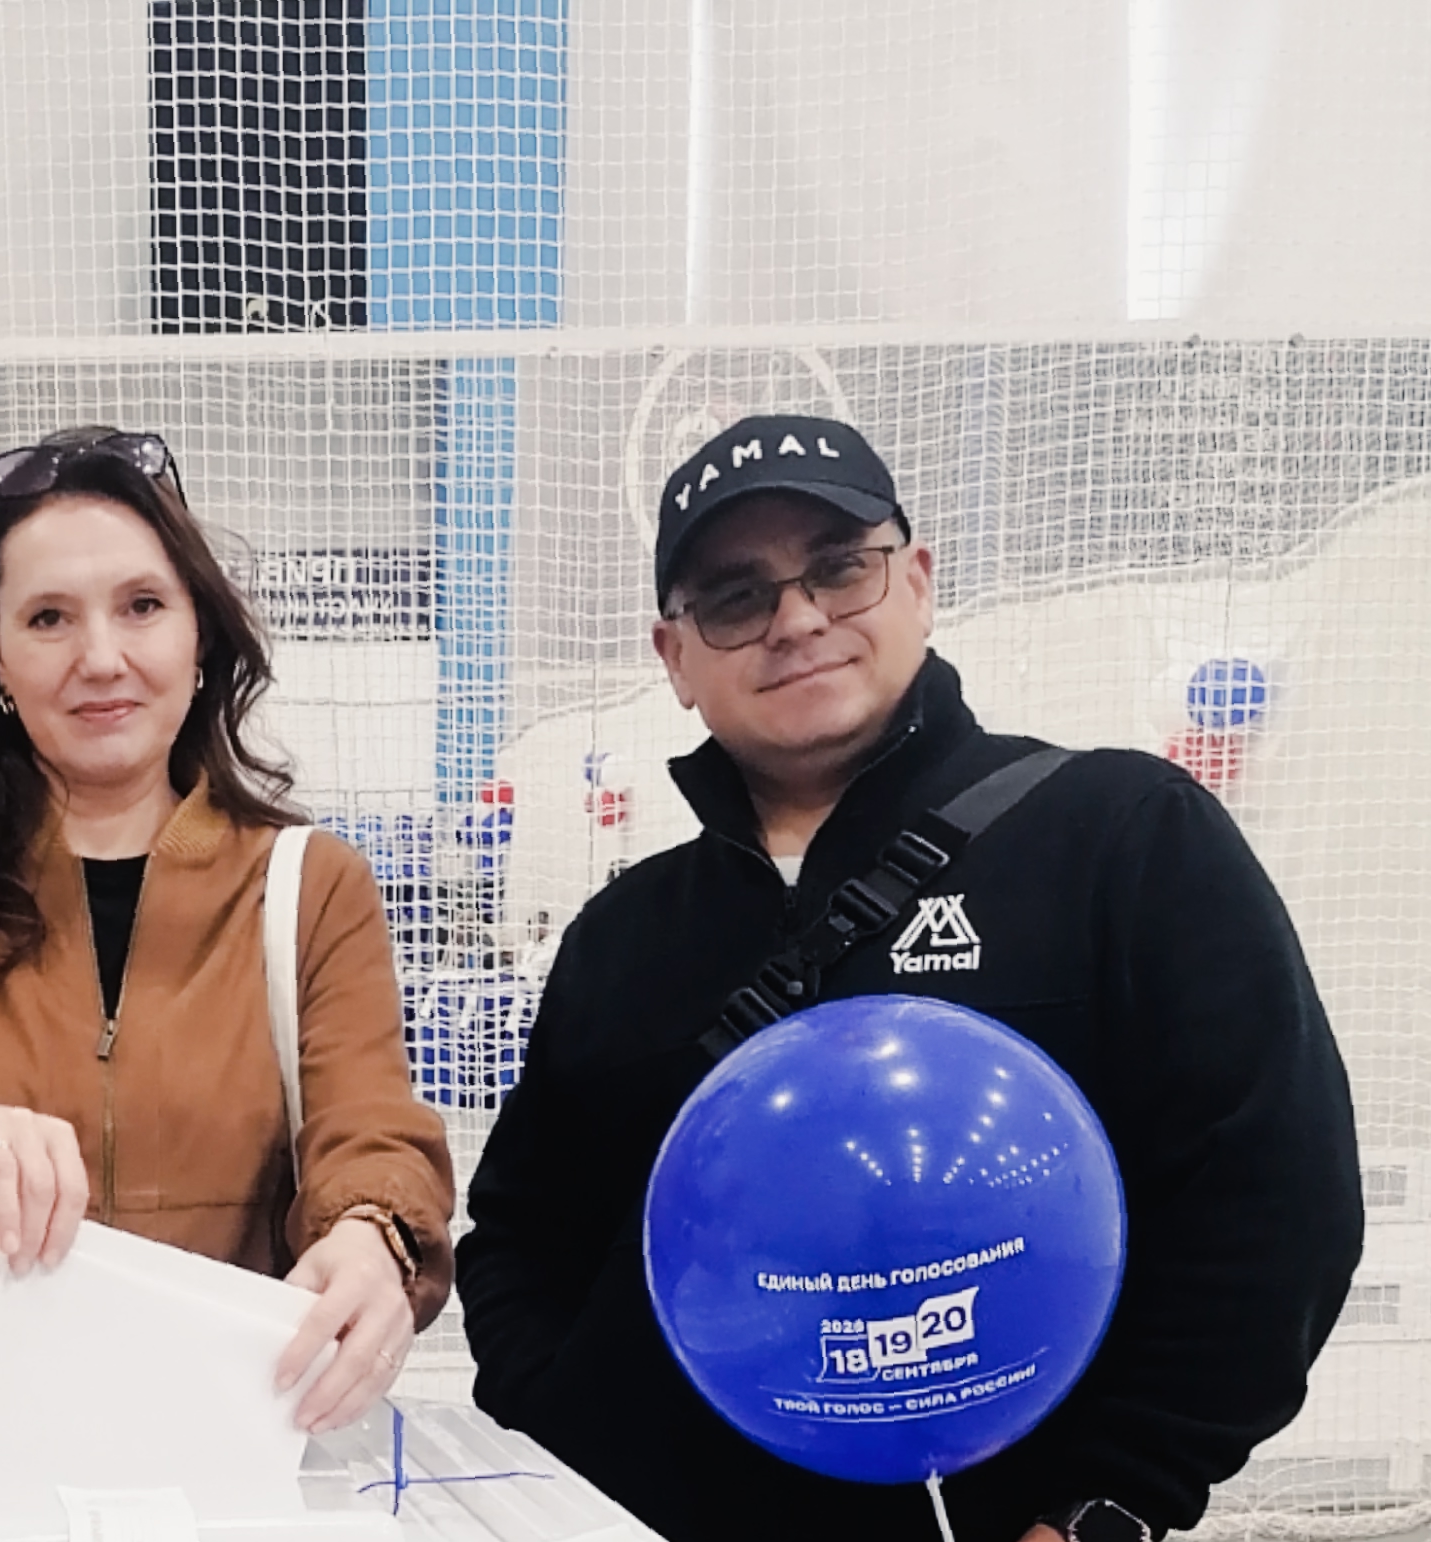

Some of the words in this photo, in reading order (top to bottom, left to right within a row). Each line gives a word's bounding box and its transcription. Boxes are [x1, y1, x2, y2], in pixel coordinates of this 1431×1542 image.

[674, 433, 841, 511] YAMAL
[889, 944, 981, 974] Yamal
[758, 1273, 833, 1291] ЕДИНЫЙ
[838, 1274, 887, 1292] ДЕНЬ
[890, 1237, 1024, 1285] ГОЛОСОВАНИЯ
[829, 1349, 868, 1373] 18
[875, 1331, 912, 1356] 19
[921, 1305, 967, 1340] 20
[773, 1397, 820, 1414] ТВОЙ
[823, 1401, 885, 1415] ГОЛОС
[906, 1393, 957, 1411] СИЛА
[960, 1363, 1036, 1400] РОССИИ!
[881, 1352, 979, 1381] СЕНТЯБРЯ
